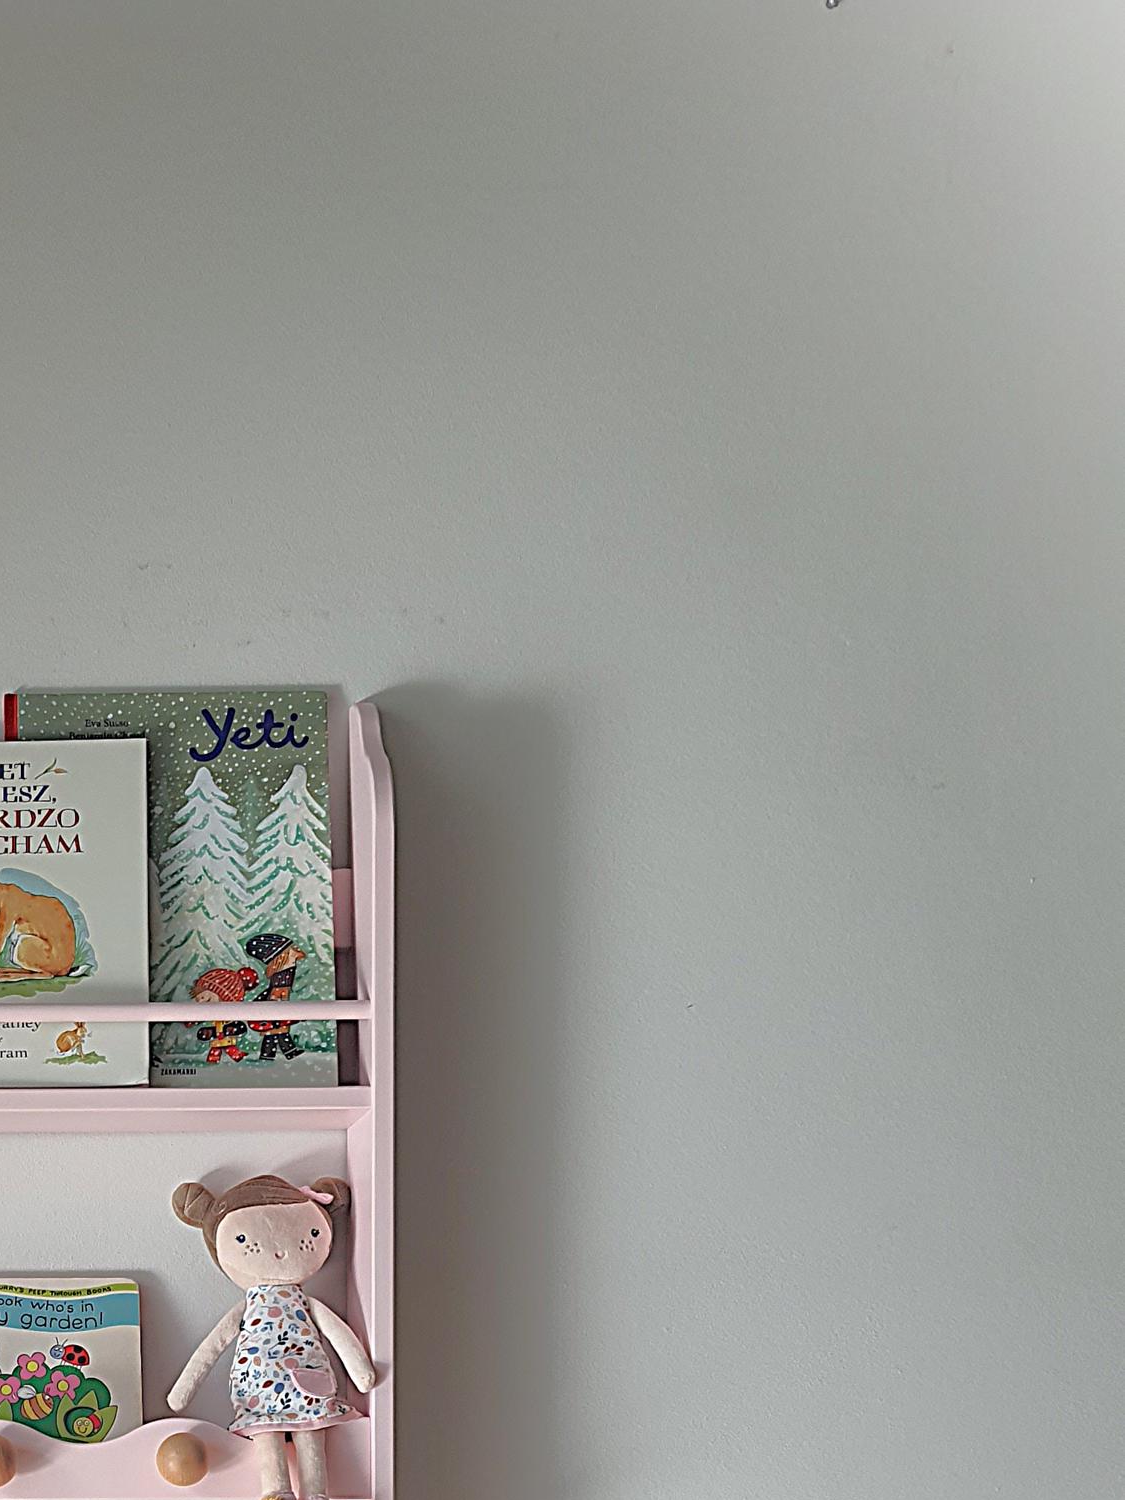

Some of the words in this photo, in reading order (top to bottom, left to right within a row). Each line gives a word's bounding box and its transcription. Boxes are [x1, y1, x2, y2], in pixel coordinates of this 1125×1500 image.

[189, 707, 310, 762] Yeti
[28, 1288, 46, 1296] PEEP
[86, 1286, 112, 1295] BOOKS
[30, 1300, 75, 1313] who's
[81, 1300, 94, 1313] in
[20, 1311, 103, 1330] garden!
